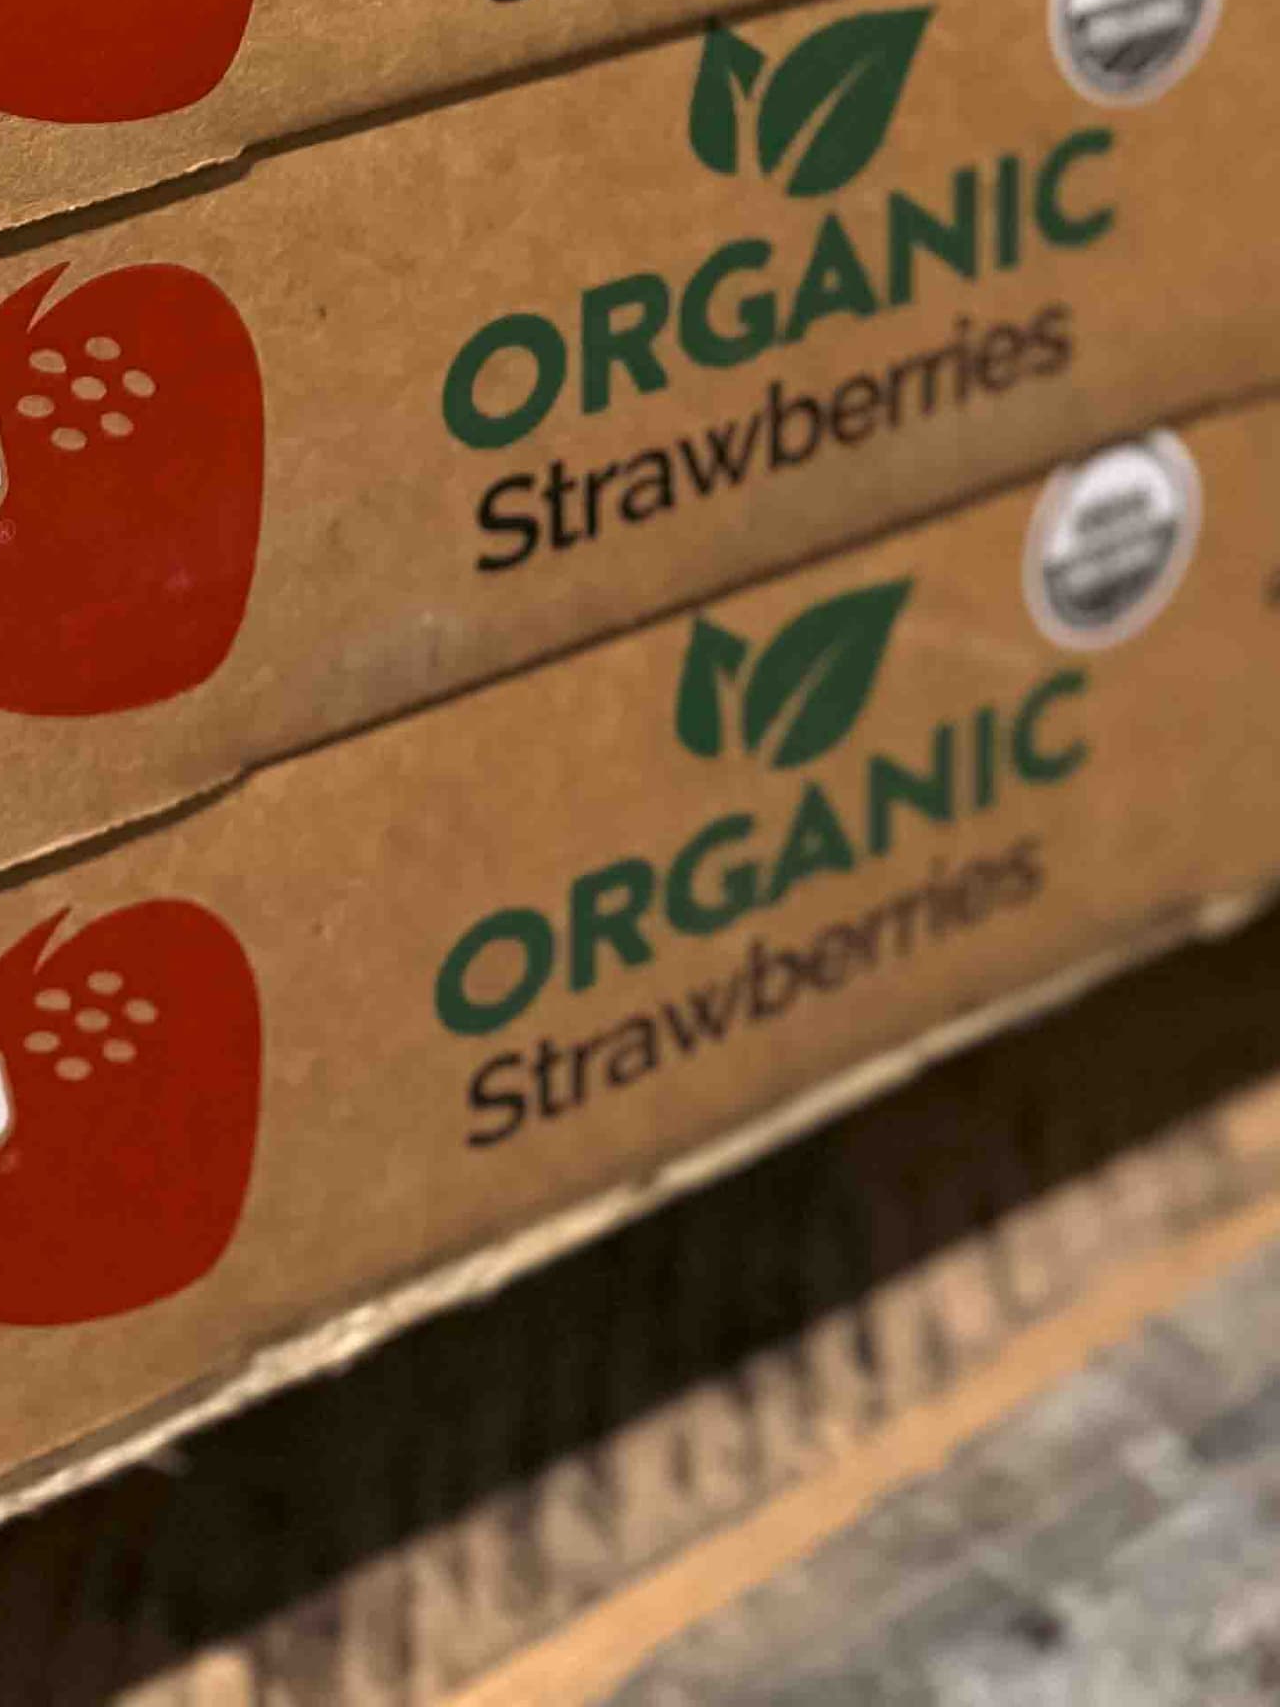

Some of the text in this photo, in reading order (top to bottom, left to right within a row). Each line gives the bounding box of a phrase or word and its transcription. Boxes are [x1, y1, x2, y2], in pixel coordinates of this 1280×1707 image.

[441, 128, 1117, 451] ORGANIC
[474, 303, 1074, 576] Strawberries
[434, 667, 1092, 1037] ORGANIC
